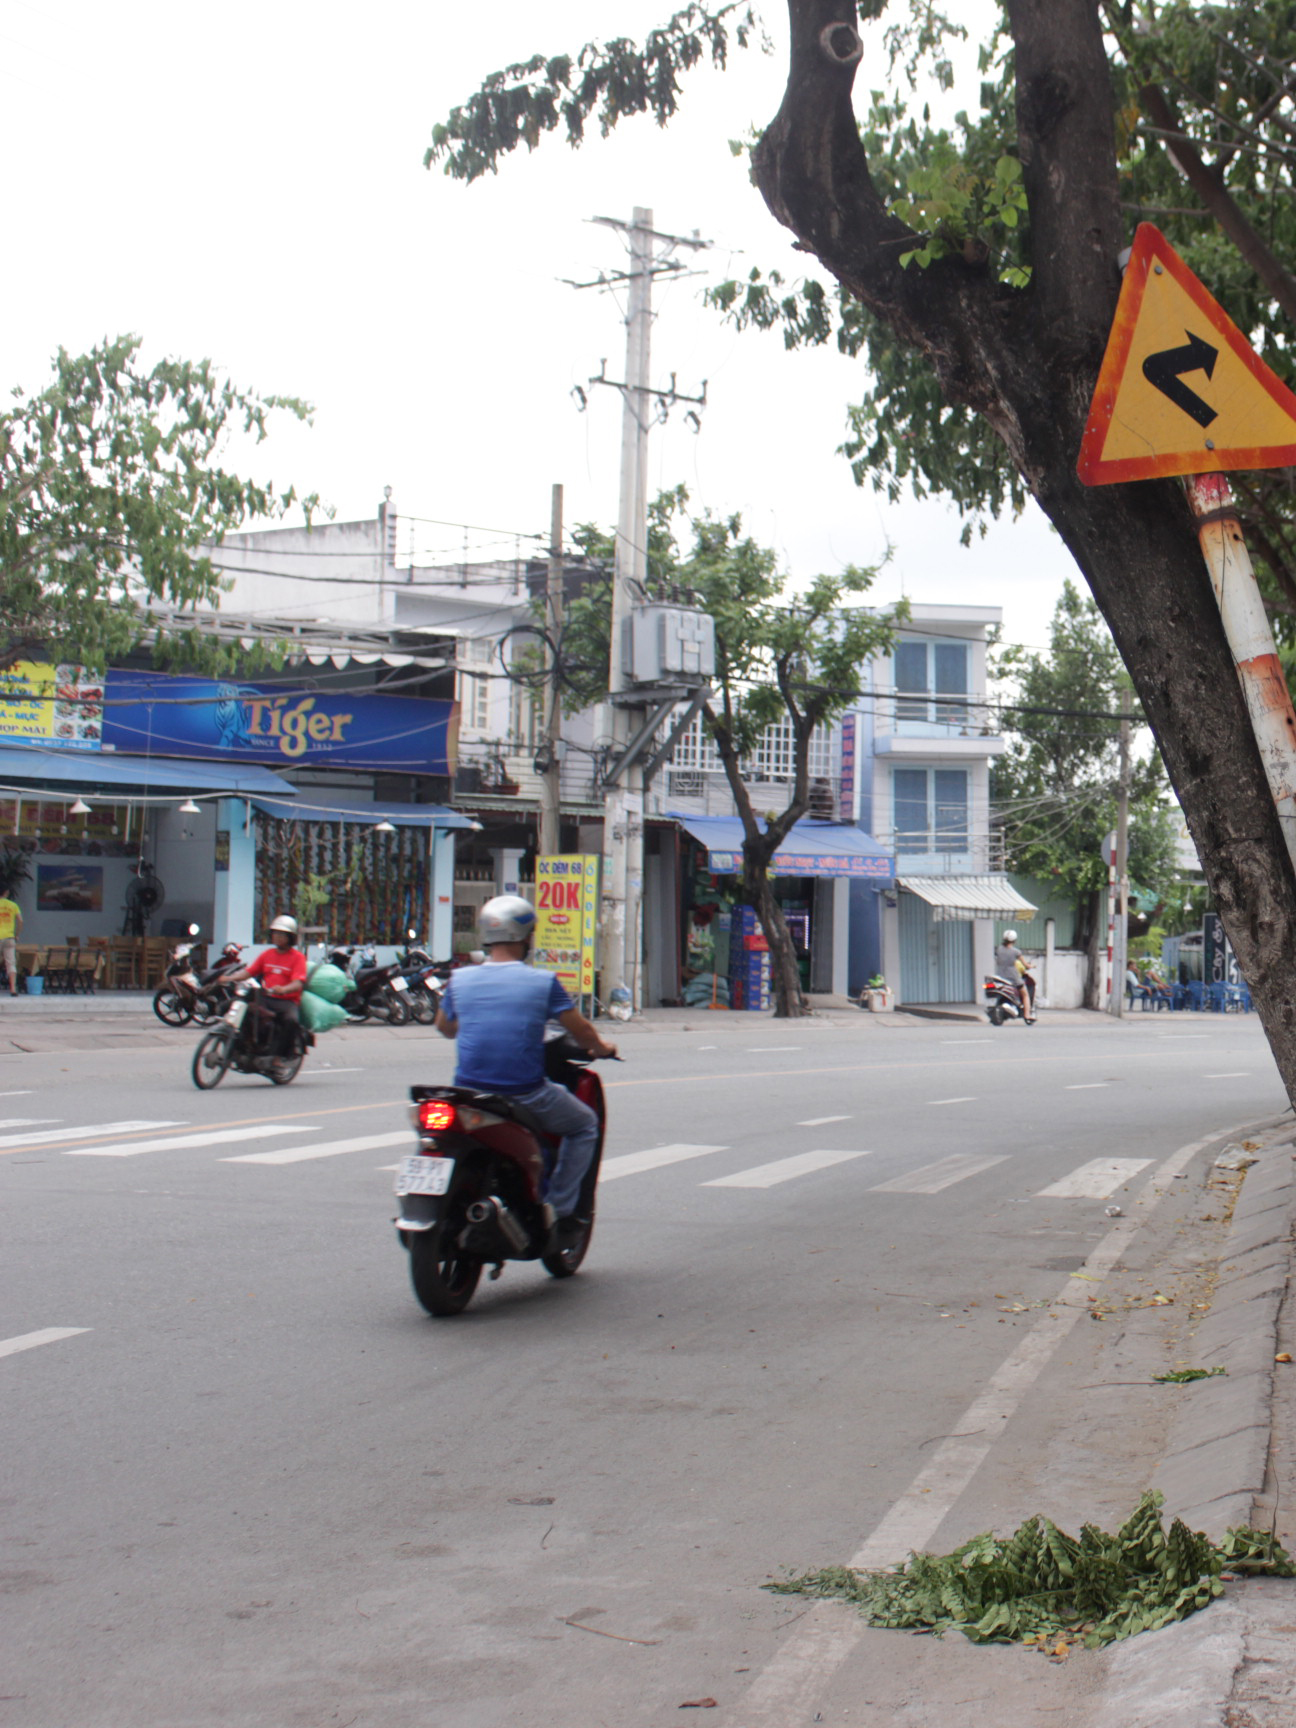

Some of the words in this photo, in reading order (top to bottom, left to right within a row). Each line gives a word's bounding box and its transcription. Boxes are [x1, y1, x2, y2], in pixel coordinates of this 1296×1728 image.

[242, 697, 353, 758] Tiger
[571, 862, 582, 875] 68
[538, 881, 582, 909] 20K
